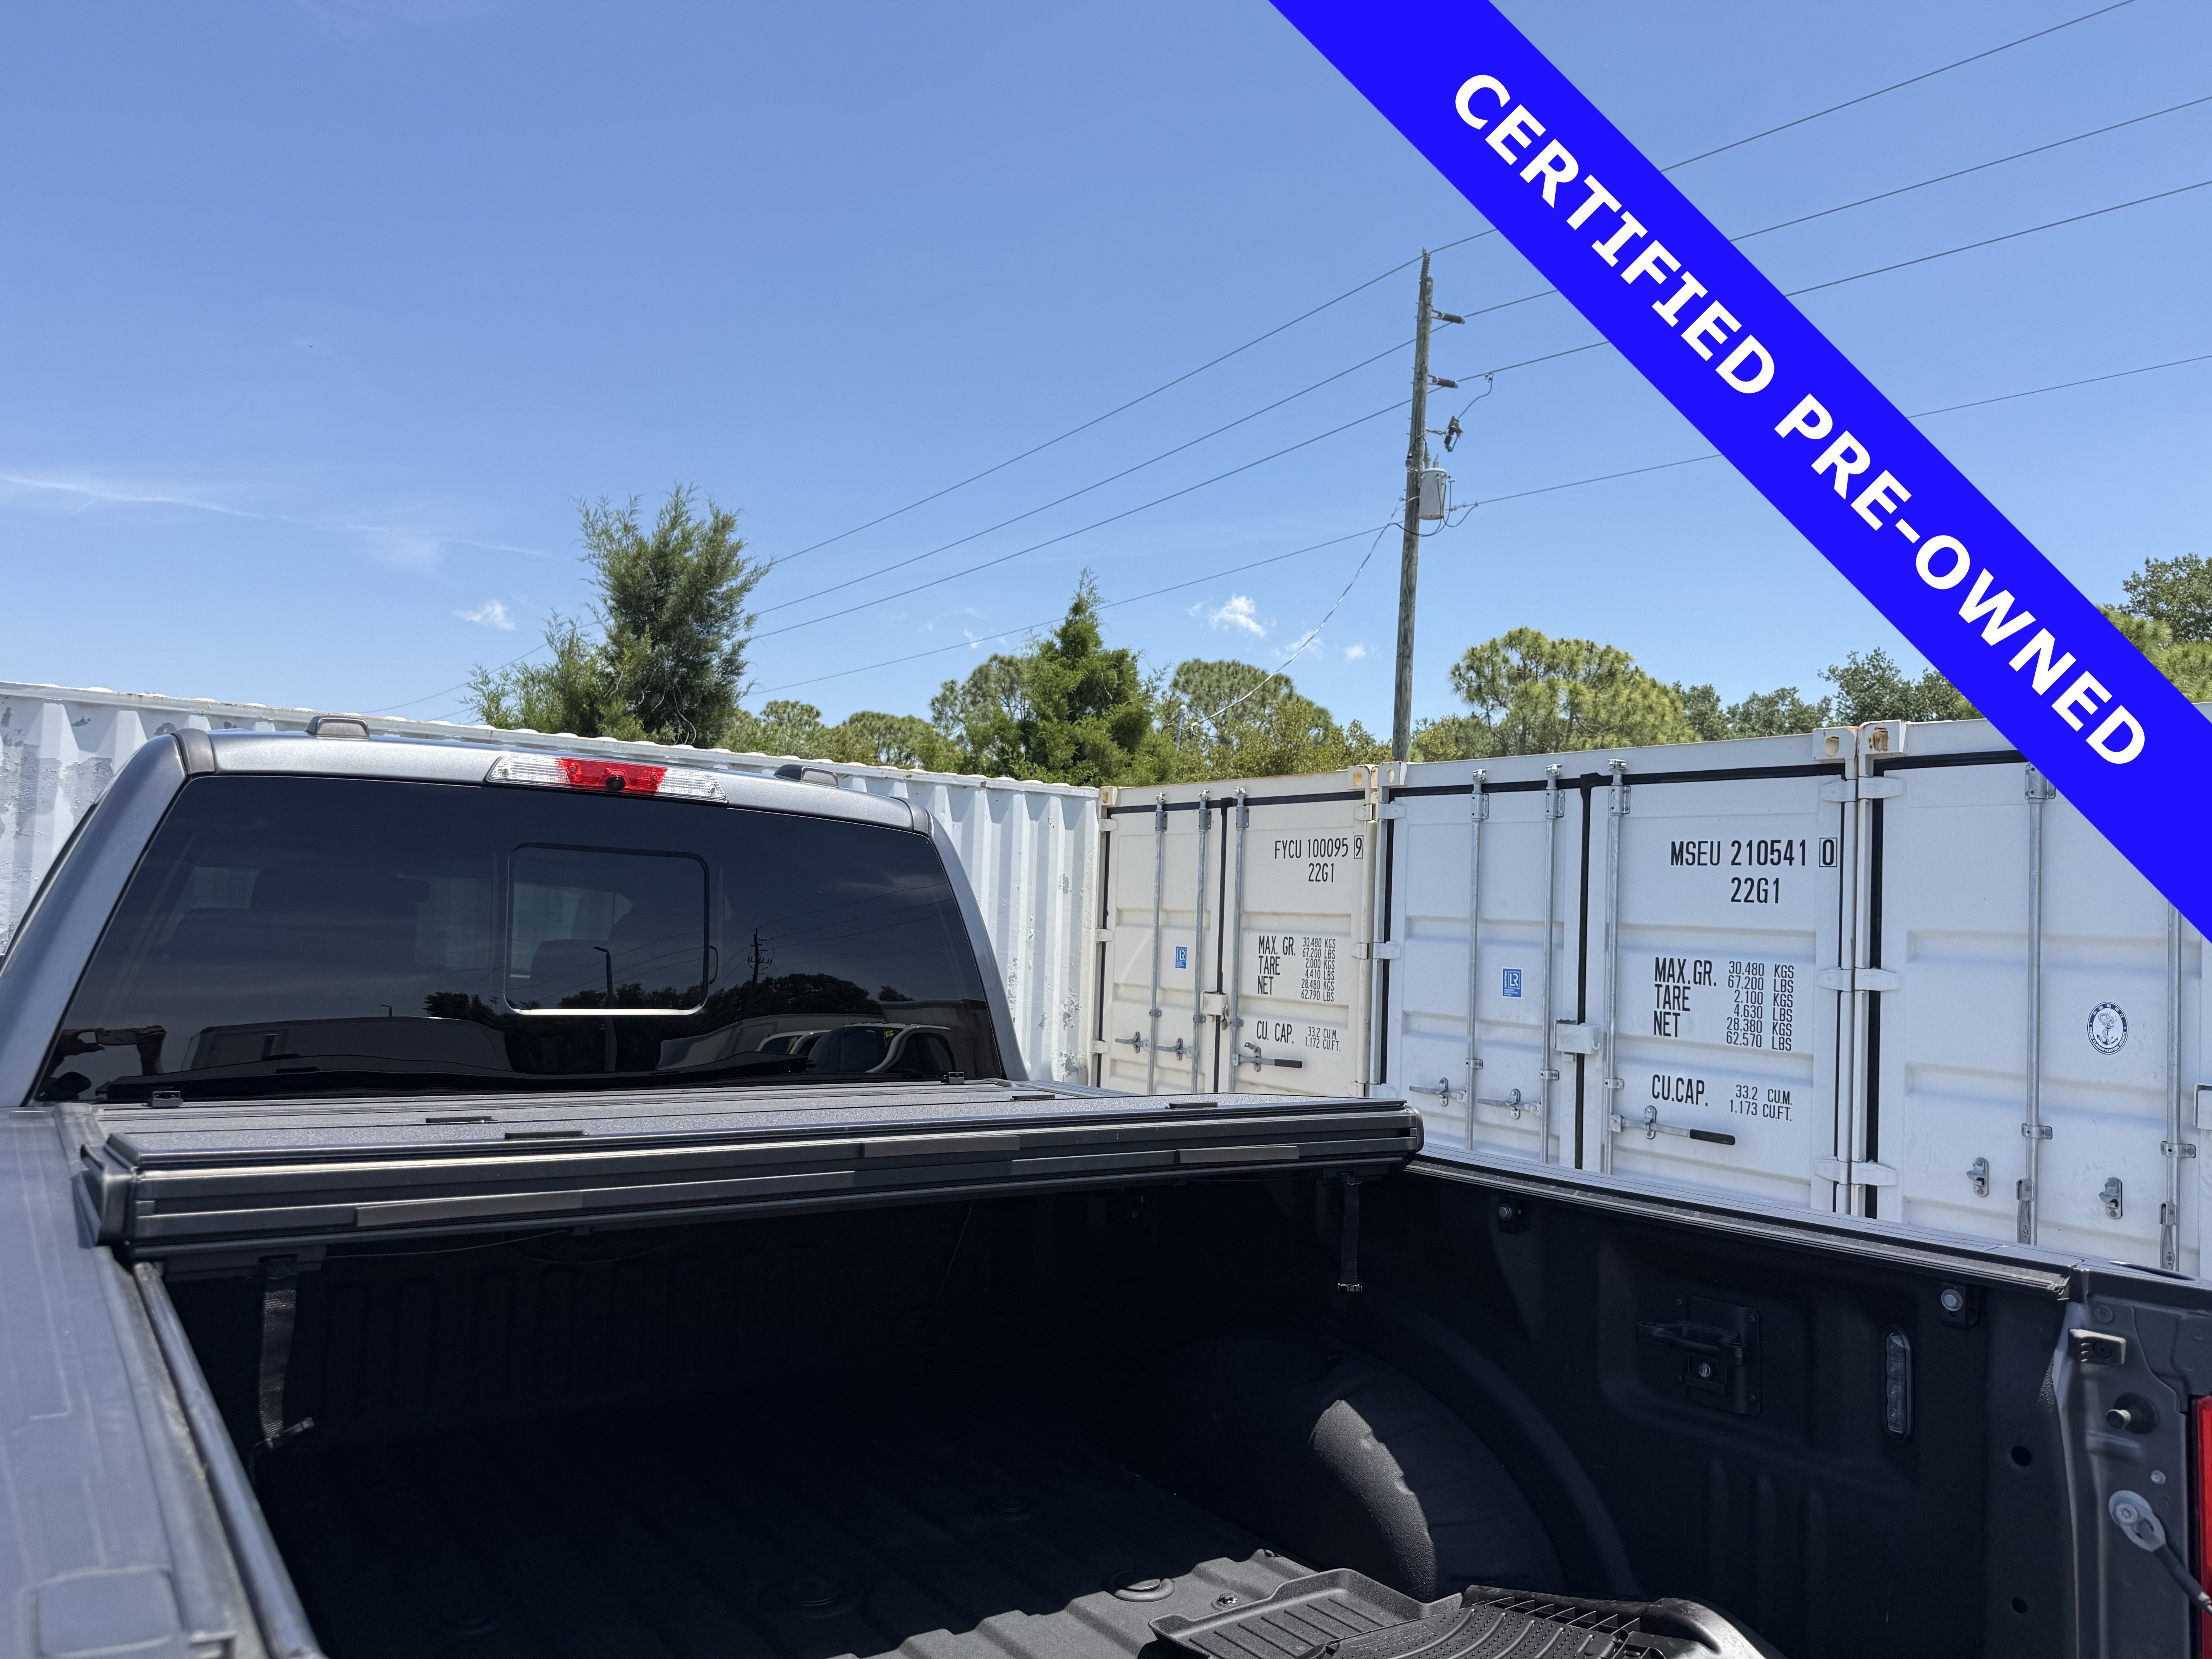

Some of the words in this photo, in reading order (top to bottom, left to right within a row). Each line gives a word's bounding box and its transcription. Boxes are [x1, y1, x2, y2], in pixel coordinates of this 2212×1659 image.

[1274, 839, 1302, 859] FYCU
[1307, 837, 1348, 858] 100095
[1355, 837, 1363, 857] 9
[1670, 840, 1721, 866] MSEU
[1731, 839, 1806, 866] 210541
[1308, 862, 1334, 883] 22G1
[1731, 877, 1779, 904] 22G1
[1259, 935, 1278, 955] MAX.
[1283, 936, 1296, 956] GR.
[1325, 938, 1336, 949] KGS
[1324, 949, 1335, 959] LBS
[1258, 955, 1281, 975] TARE
[1324, 959, 1335, 970] KGS
[1774, 964, 1794, 979] KGS
[1324, 970, 1334, 981] LBS
[1257, 975, 1274, 995] NET
[1323, 981, 1334, 991] KGS
[1774, 978, 1793, 993] LBS
[1323, 991, 1334, 1002] LBS
[1654, 984, 1691, 1012] TARE
[1773, 993, 1793, 1008] KGS
[1772, 1007, 1793, 1022] LBS
[1654, 1010, 1681, 1038] NET
[1772, 1021, 1792, 1037] KGS
[1257, 1020, 1269, 1041] CU.
[1274, 1022, 1294, 1044] CAP.
[1308, 1026, 1320, 1038] 33.2
[1323, 1028, 1338, 1040] CU.M.
[1323, 1039, 1341, 1052] CU.FT.
[1772, 1036, 1791, 1051] LBS
[1736, 1084, 1758, 1101] 33.2
[1767, 1089, 1793, 1106] CU.M.
[1762, 1104, 1792, 1121] CU.FT.
